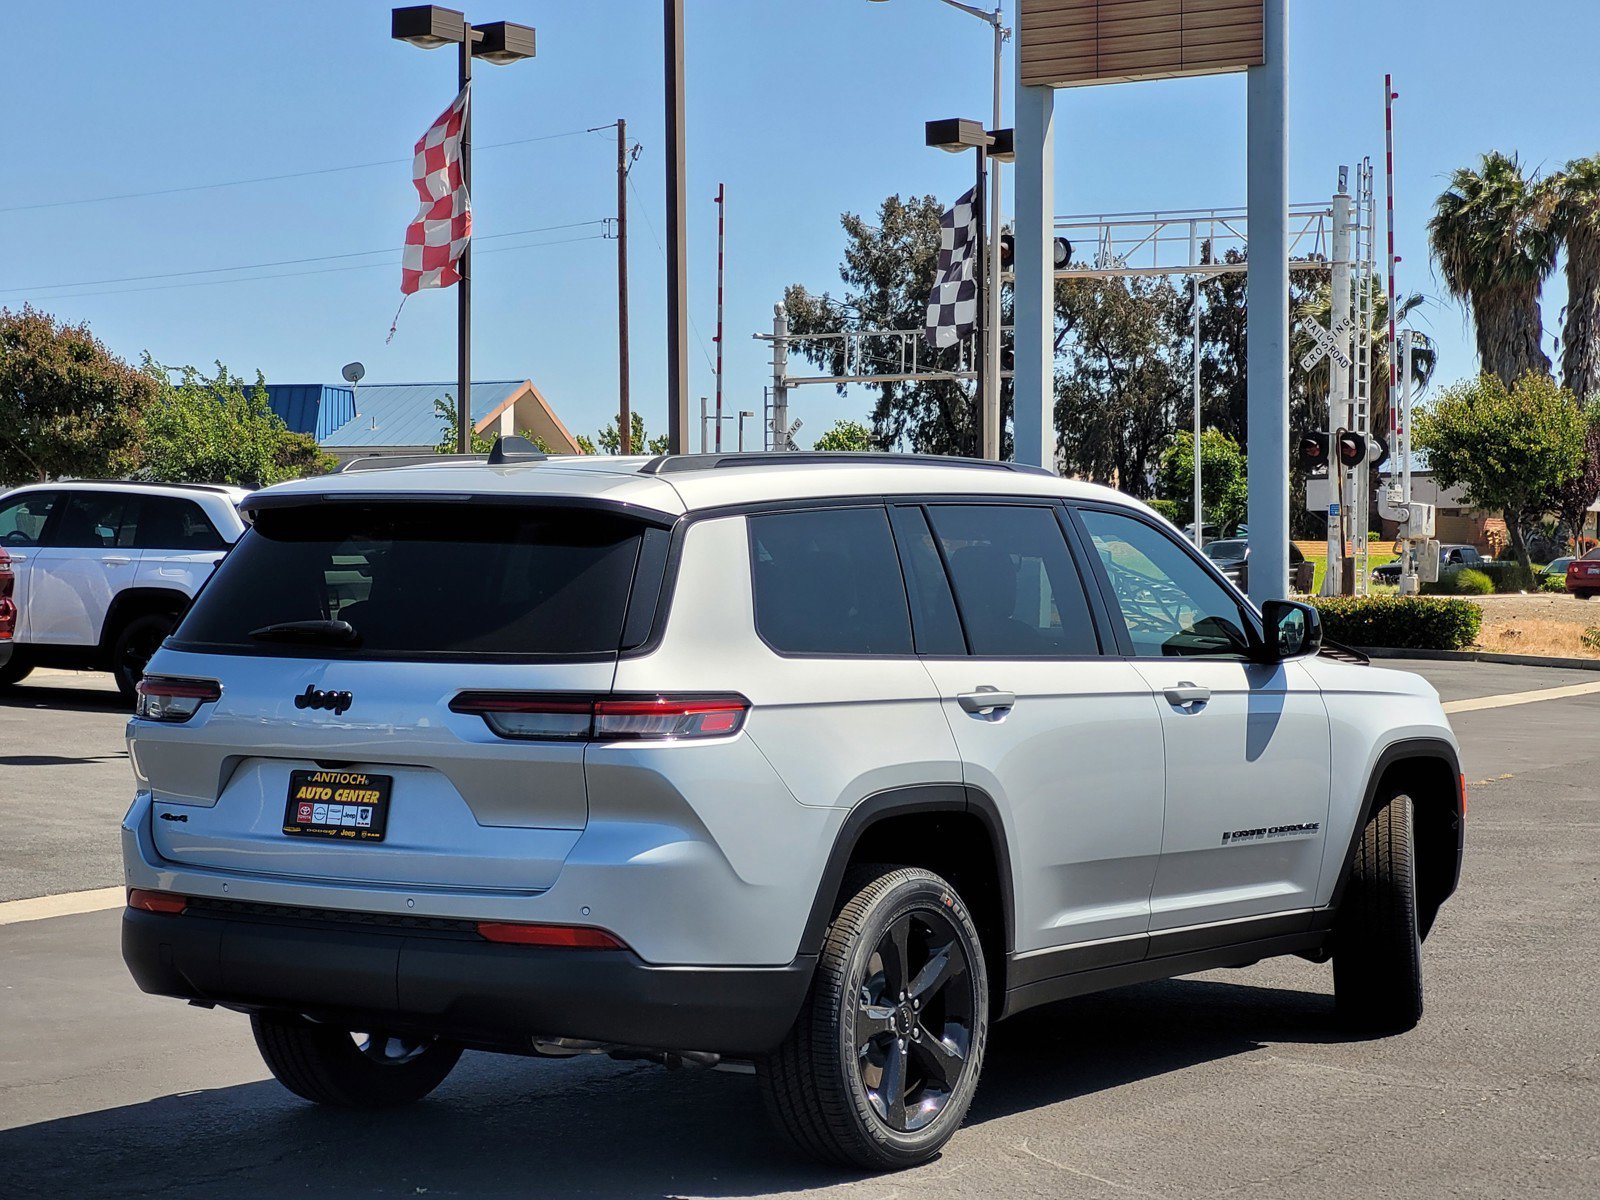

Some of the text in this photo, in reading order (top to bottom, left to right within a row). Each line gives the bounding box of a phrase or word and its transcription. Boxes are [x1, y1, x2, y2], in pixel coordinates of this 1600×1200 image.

[1303, 318, 1350, 368] CROSSING
[1304, 318, 1348, 369] RAIL ROAD
[294, 684, 353, 716] Jeep
[312, 772, 366, 785] ANTIOCH
[297, 786, 380, 803] AUTO CENTER
[341, 829, 356, 837] Jeep
[1268, 822, 1320, 834] CHEROKEE
